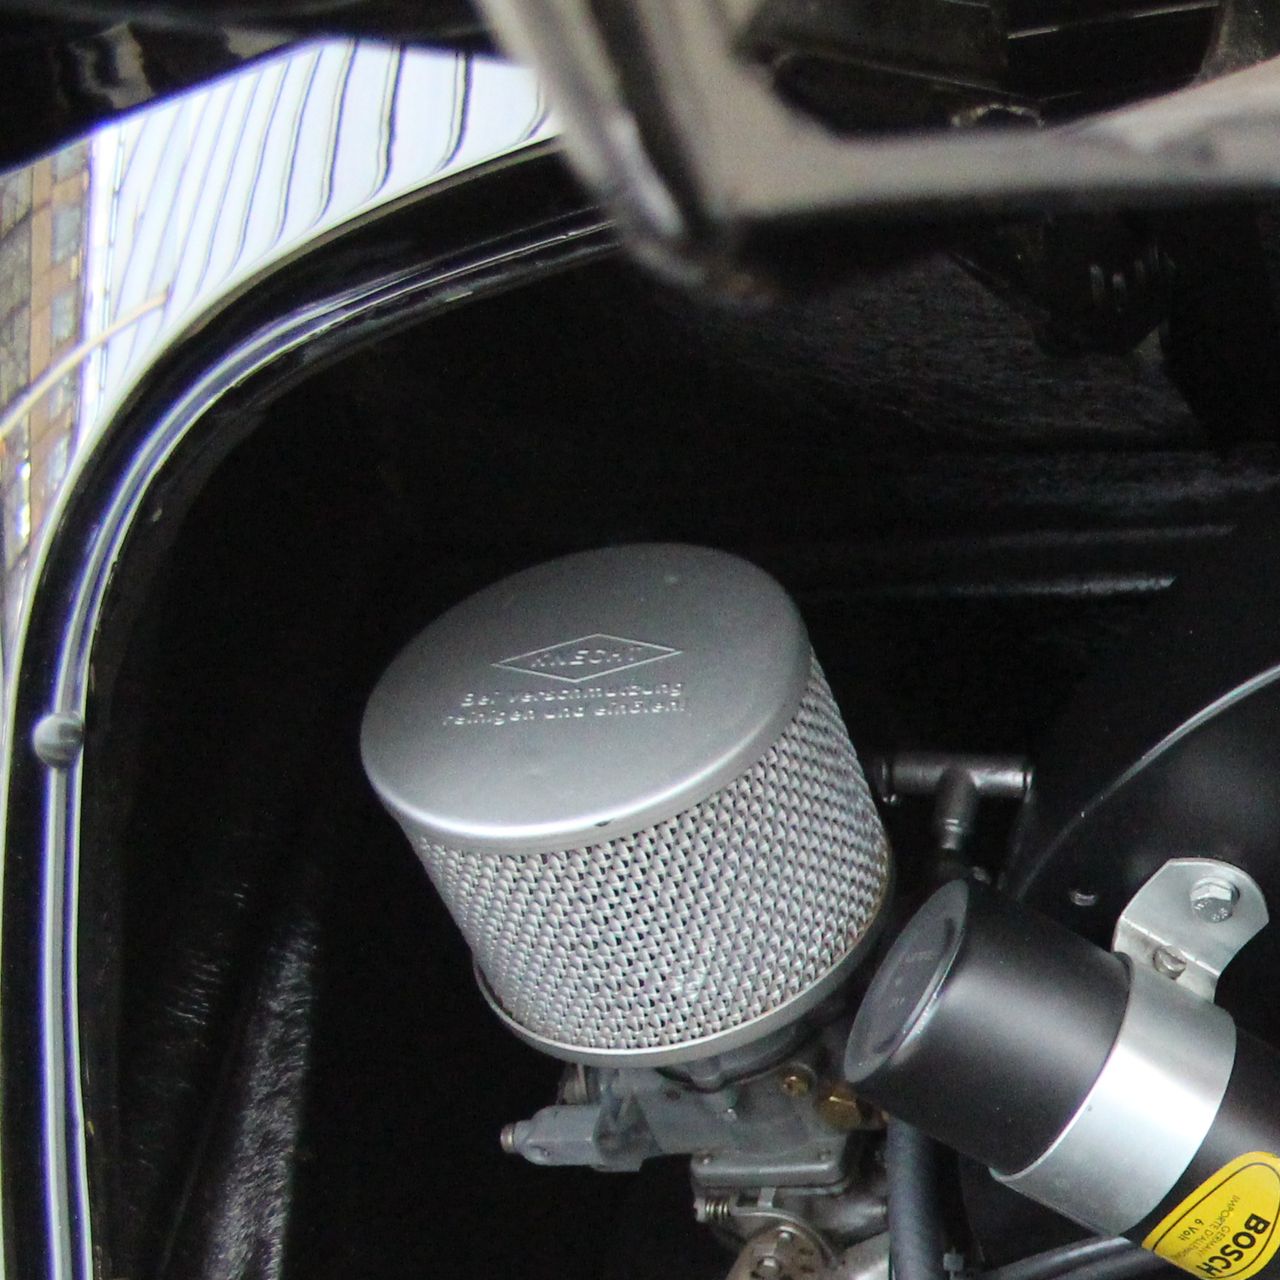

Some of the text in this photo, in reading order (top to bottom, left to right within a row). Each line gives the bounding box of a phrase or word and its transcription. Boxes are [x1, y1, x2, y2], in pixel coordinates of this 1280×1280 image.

[1177, 1218, 1205, 1242] 6 Volt
[1208, 1195, 1241, 1231] IMPORTE
[1196, 1212, 1272, 1277] BOSCH
